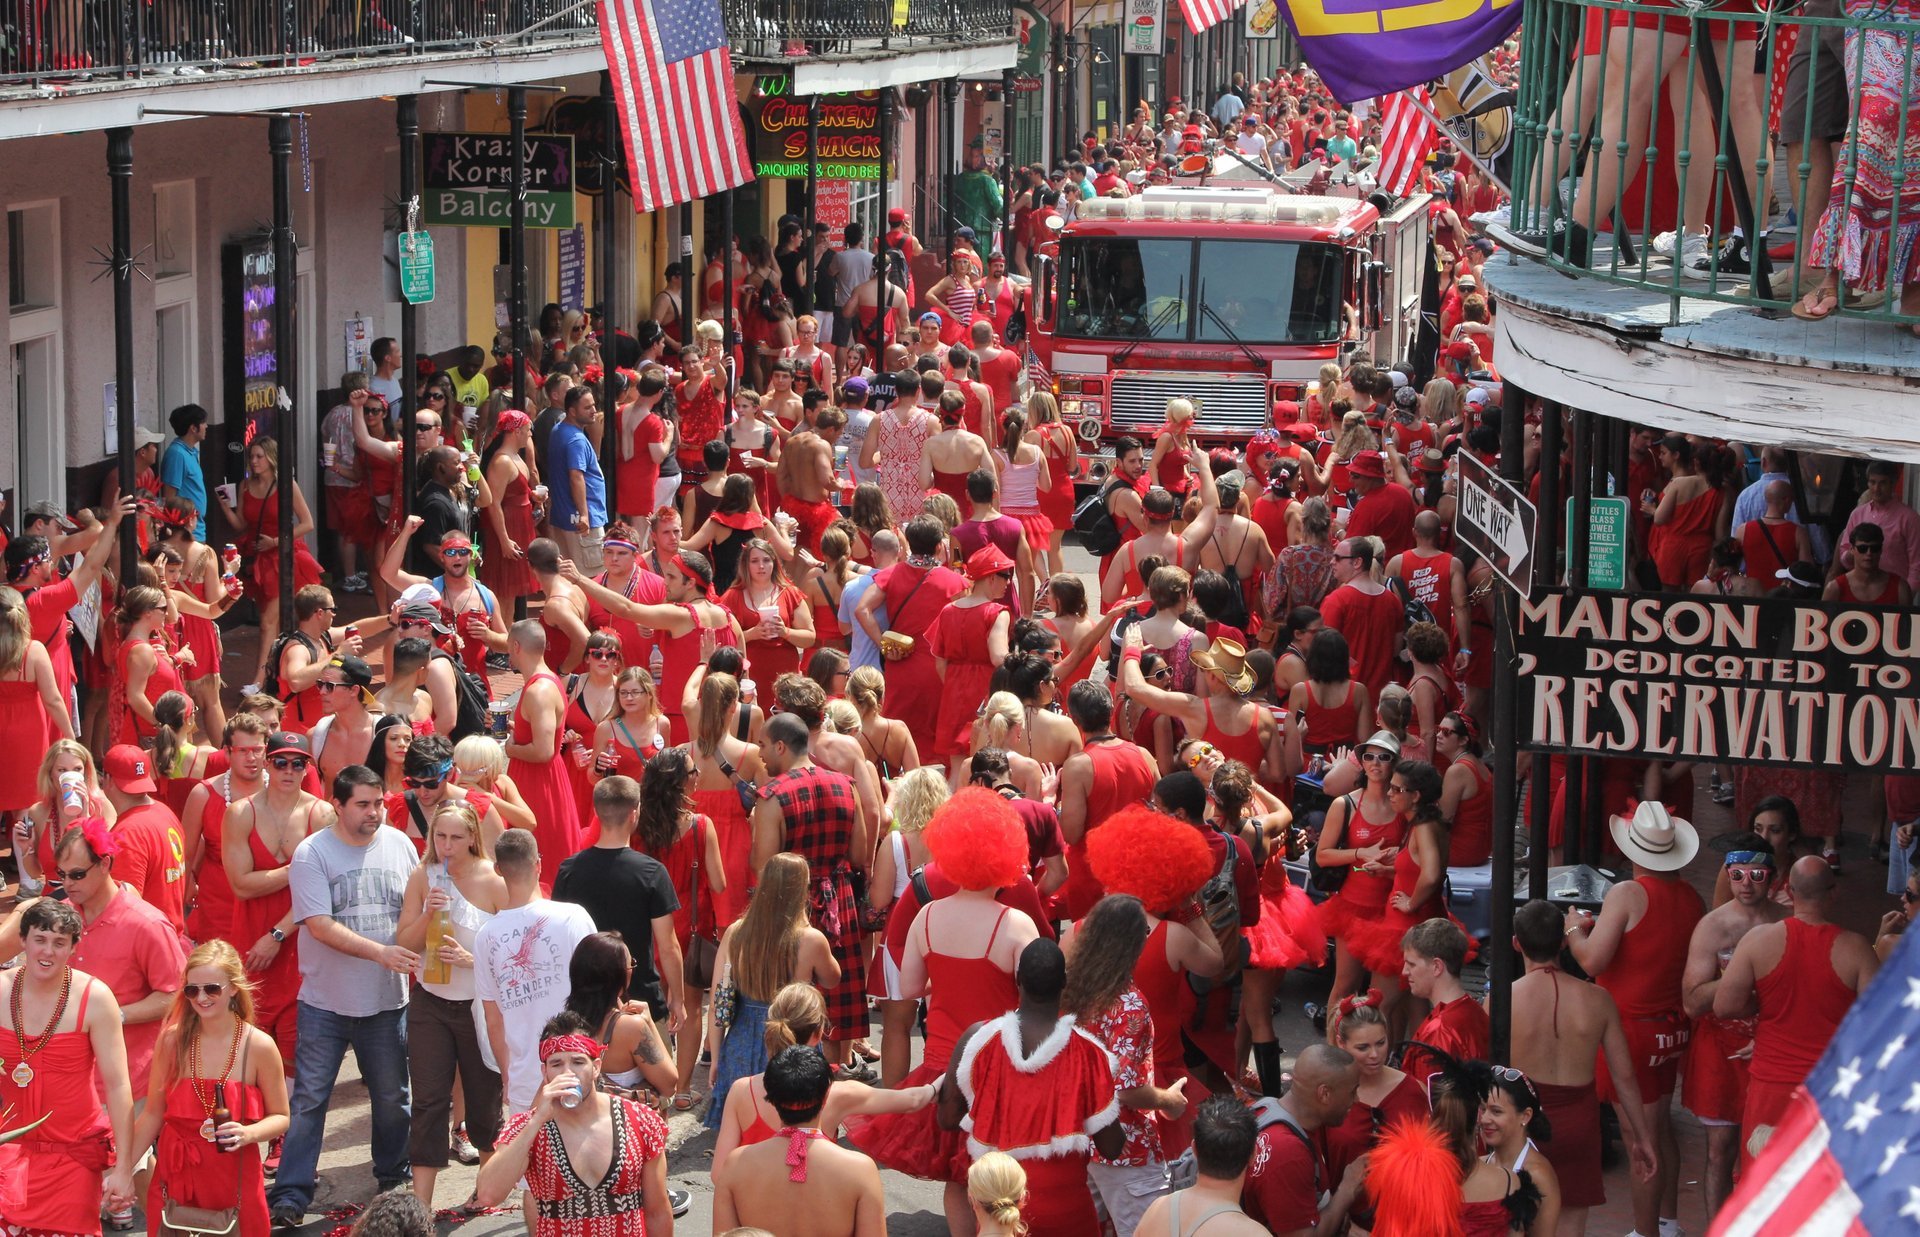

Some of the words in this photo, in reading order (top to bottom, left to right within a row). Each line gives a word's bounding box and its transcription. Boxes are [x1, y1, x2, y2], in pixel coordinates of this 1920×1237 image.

[827, 164, 857, 178] COLD
[860, 165, 880, 178] BEE
[1176, 350, 1235, 361] ORLEANS
[245, 386, 276, 413] PATIO
[1465, 483, 1487, 528] ONE
[1490, 501, 1512, 547] WAY
[1590, 506, 1619, 516] OTTLES
[1589, 515, 1615, 524] GLASS
[1590, 524, 1613, 533] OWED
[1589, 532, 1616, 542] STREET
[1413, 566, 1432, 579] RED
[1409, 573, 1439, 589] DRESS
[1415, 584, 1435, 597] RUN
[1519, 594, 1760, 649] MAISON
[1849, 663, 1912, 690] TO
[329, 867, 404, 915] OHIO
[500, 975, 552, 1003] EFENDERS
